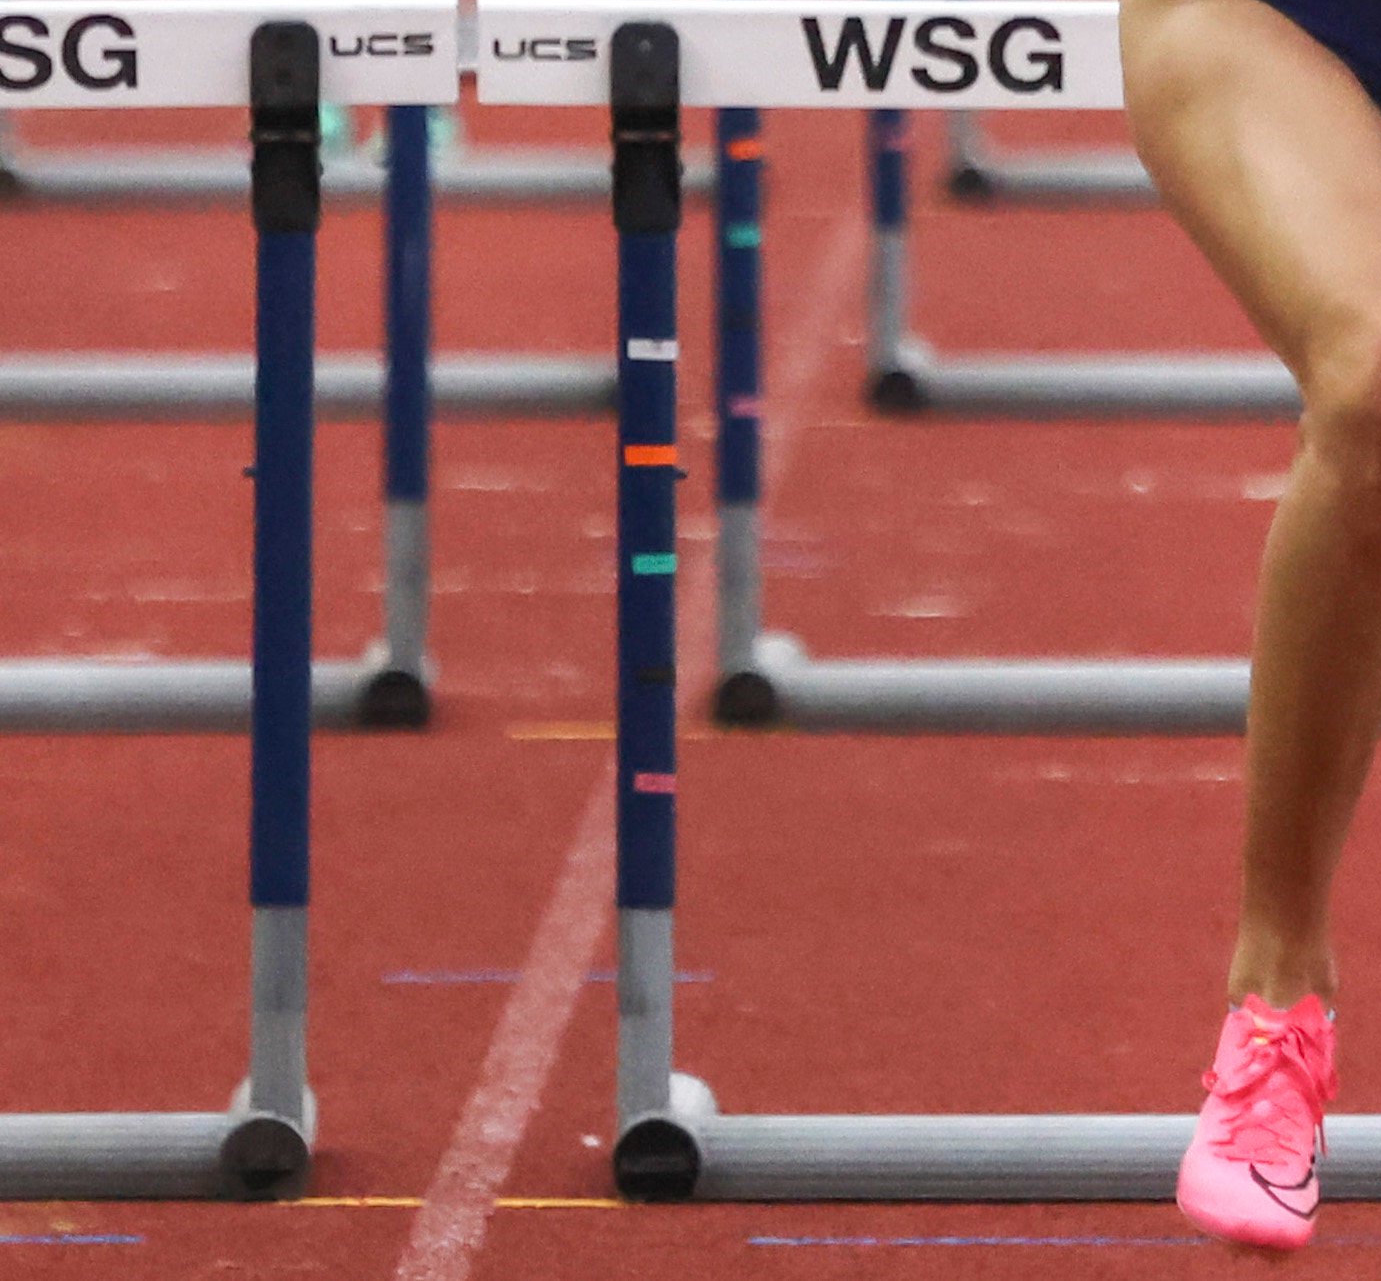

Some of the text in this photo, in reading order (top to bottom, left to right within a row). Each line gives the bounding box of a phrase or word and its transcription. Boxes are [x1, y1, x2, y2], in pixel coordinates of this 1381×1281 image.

[330, 33, 434, 57] UCS
[493, 38, 596, 60] UCS
[802, 16, 1064, 92] WSG
